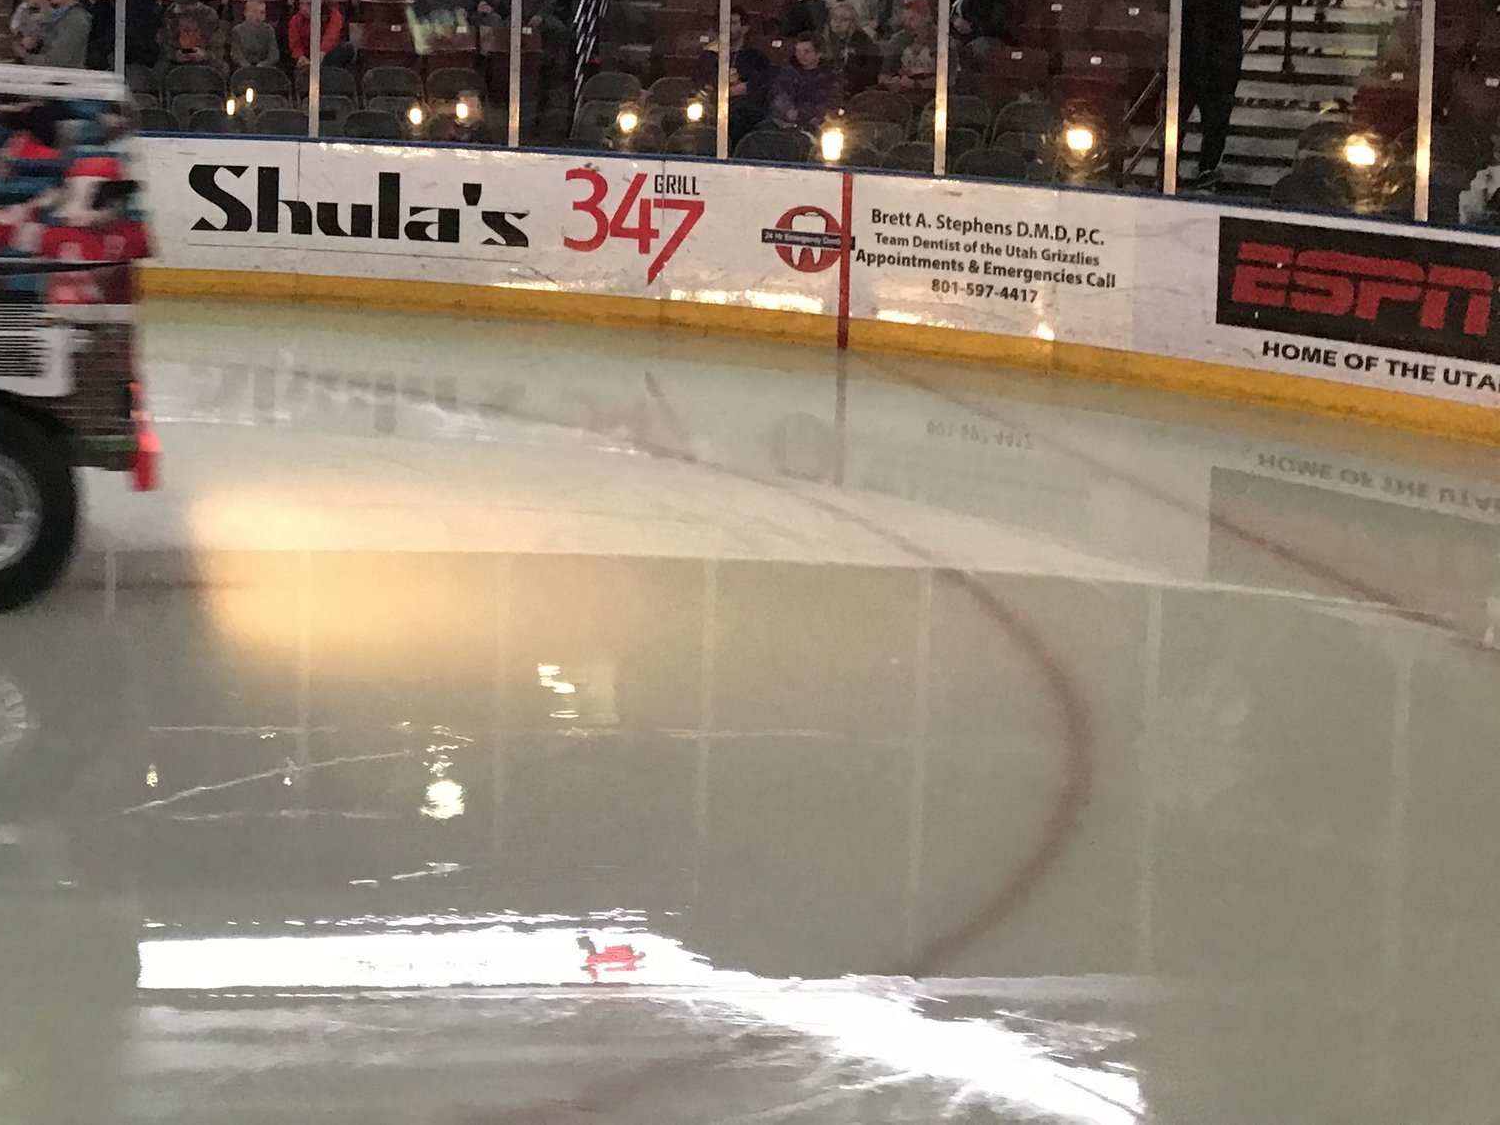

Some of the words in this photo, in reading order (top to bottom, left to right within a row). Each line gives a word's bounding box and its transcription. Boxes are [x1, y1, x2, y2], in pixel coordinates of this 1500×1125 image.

[654, 174, 701, 196] GRILL
[188, 164, 530, 248] Shula's
[563, 168, 705, 285] 347
[871, 208, 911, 227] Brett
[916, 213, 932, 229] A.
[936, 215, 1013, 236] Stephens
[1017, 221, 1071, 244] D.M.D,
[1076, 227, 1105, 246] P.C.
[855, 249, 965, 273] Appointments
[968, 259, 980, 274] &
[983, 260, 1083, 284] Emergencies
[1086, 272, 1117, 289] Call
[874, 232, 910, 247] Team
[912, 235, 961, 252] Dentist
[963, 241, 978, 253] of
[980, 242, 1003, 256] the
[1005, 244, 1038, 260] Utah
[1041, 248, 1100, 267] Grizzlies
[931, 278, 1039, 303] 801-597-4417
[1231, 241, 1493, 337] ESPN
[1261, 340, 1339, 367] HOME
[1344, 353, 1379, 373] OF
[1385, 358, 1437, 382] THE
[1443, 369, 1500, 394] UTA
